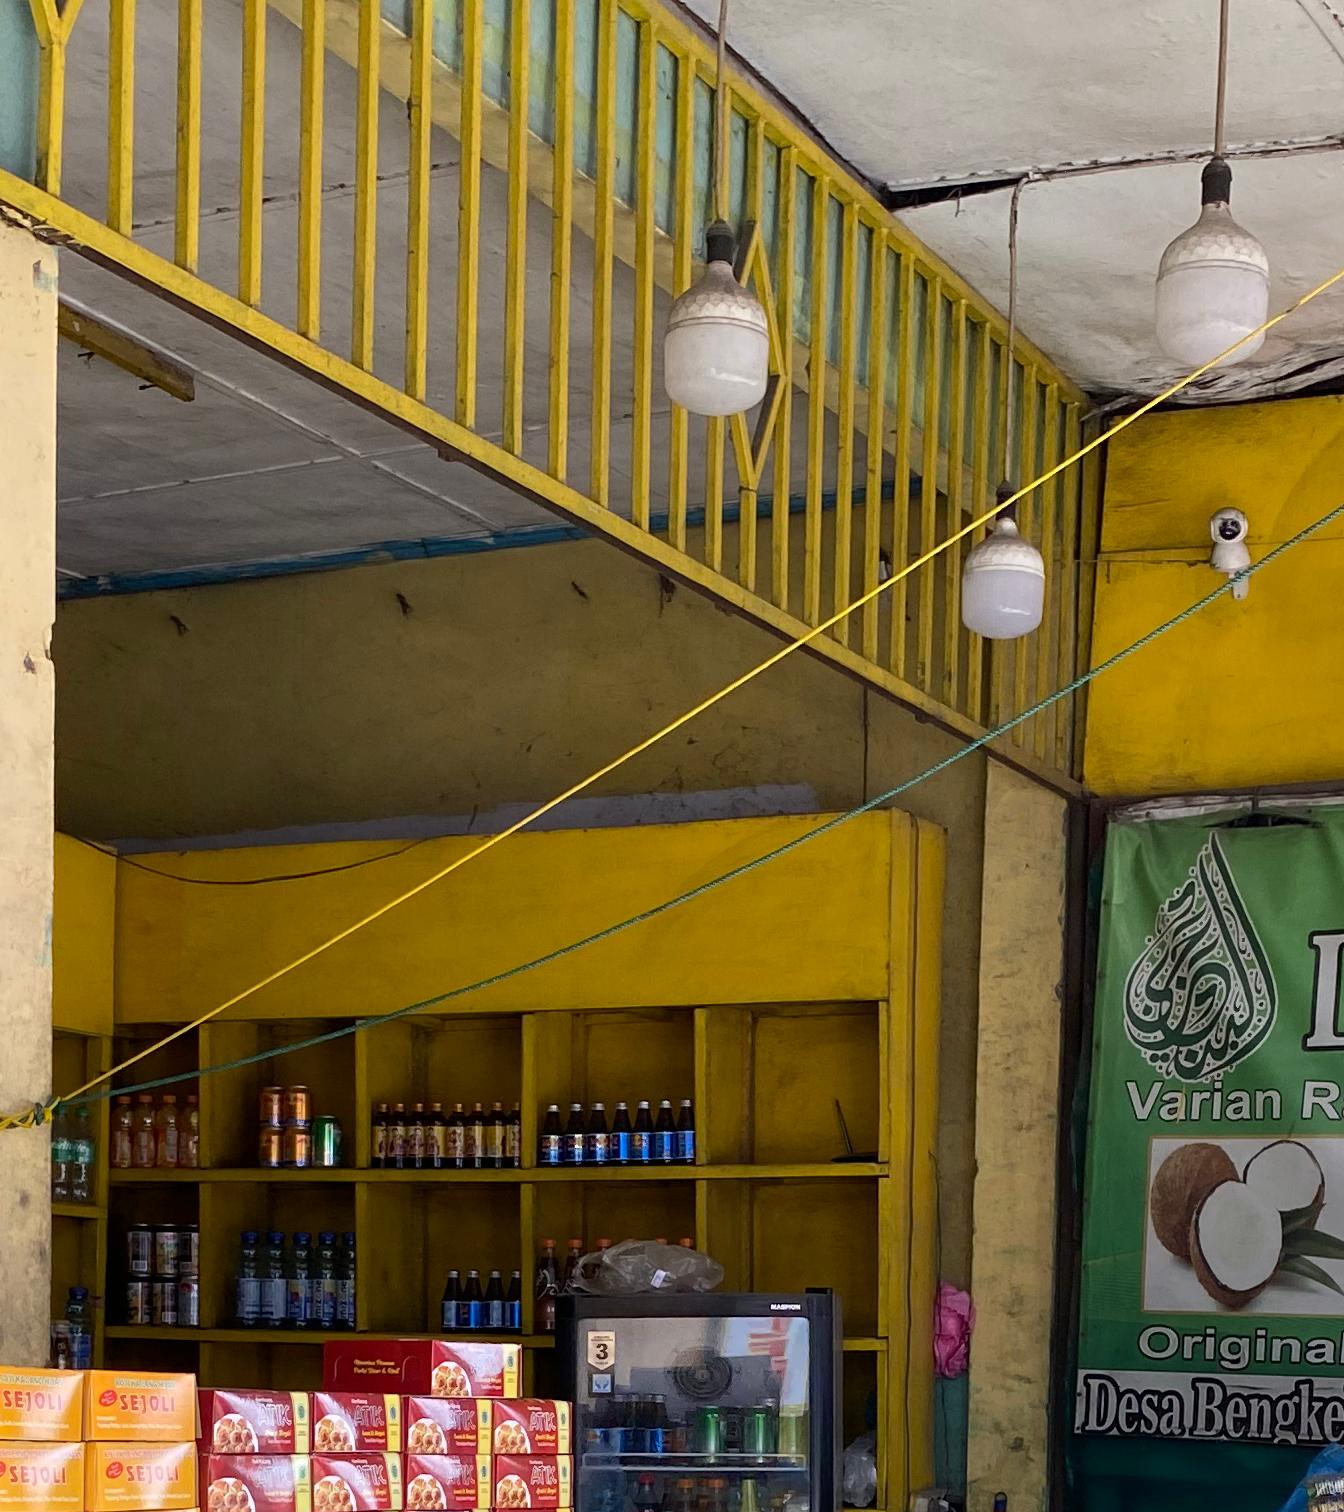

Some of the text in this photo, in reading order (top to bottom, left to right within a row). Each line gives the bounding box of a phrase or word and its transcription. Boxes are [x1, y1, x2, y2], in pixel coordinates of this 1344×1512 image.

[1126, 1080, 1282, 1122] Varian
[596, 1343, 609, 1361] 3
[2, 1389, 64, 1412] SEJOLI
[119, 1394, 176, 1414] SEJOLI
[1083, 1377, 1183, 1437] Desa
[9, 1463, 67, 1486] SEJOLI
[126, 1464, 180, 1485] SEJOLI
